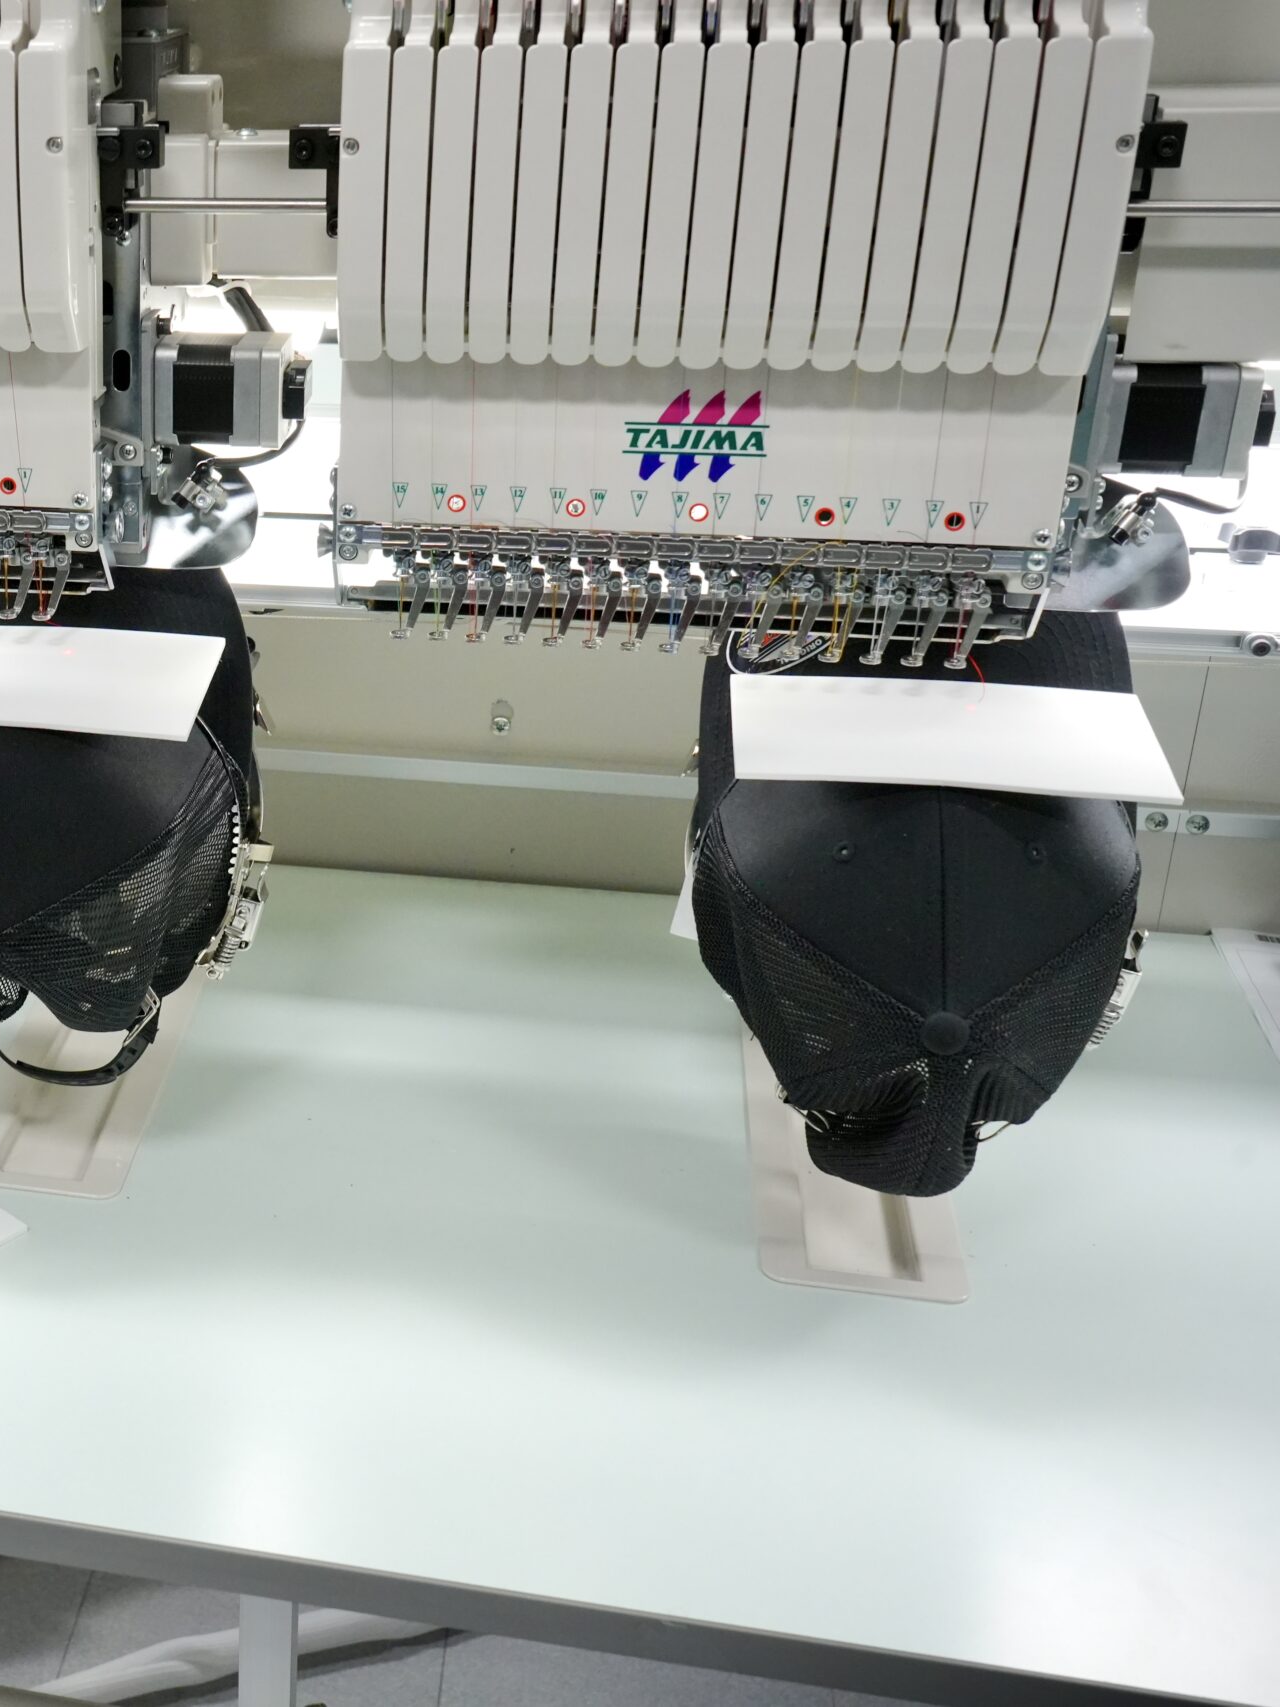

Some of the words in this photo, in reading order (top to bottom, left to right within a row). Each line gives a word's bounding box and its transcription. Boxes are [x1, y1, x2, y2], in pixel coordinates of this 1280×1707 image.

[626, 428, 765, 452] TAJIMA
[23, 471, 27, 479] 1
[396, 485, 406, 493] 15
[434, 486, 444, 494] 14
[474, 488, 484, 496] 13
[513, 489, 524, 497] 12
[552, 491, 562, 499] 11
[594, 492, 604, 500] 10
[636, 493, 642, 501] 9
[719, 496, 725, 504] 7
[760, 497, 766, 505] 6
[802, 498, 809, 507] 5
[844, 500, 851, 508] 4
[888, 502, 894, 510] 3
[931, 504, 938, 512] 2
[976, 504, 980, 514] 1
